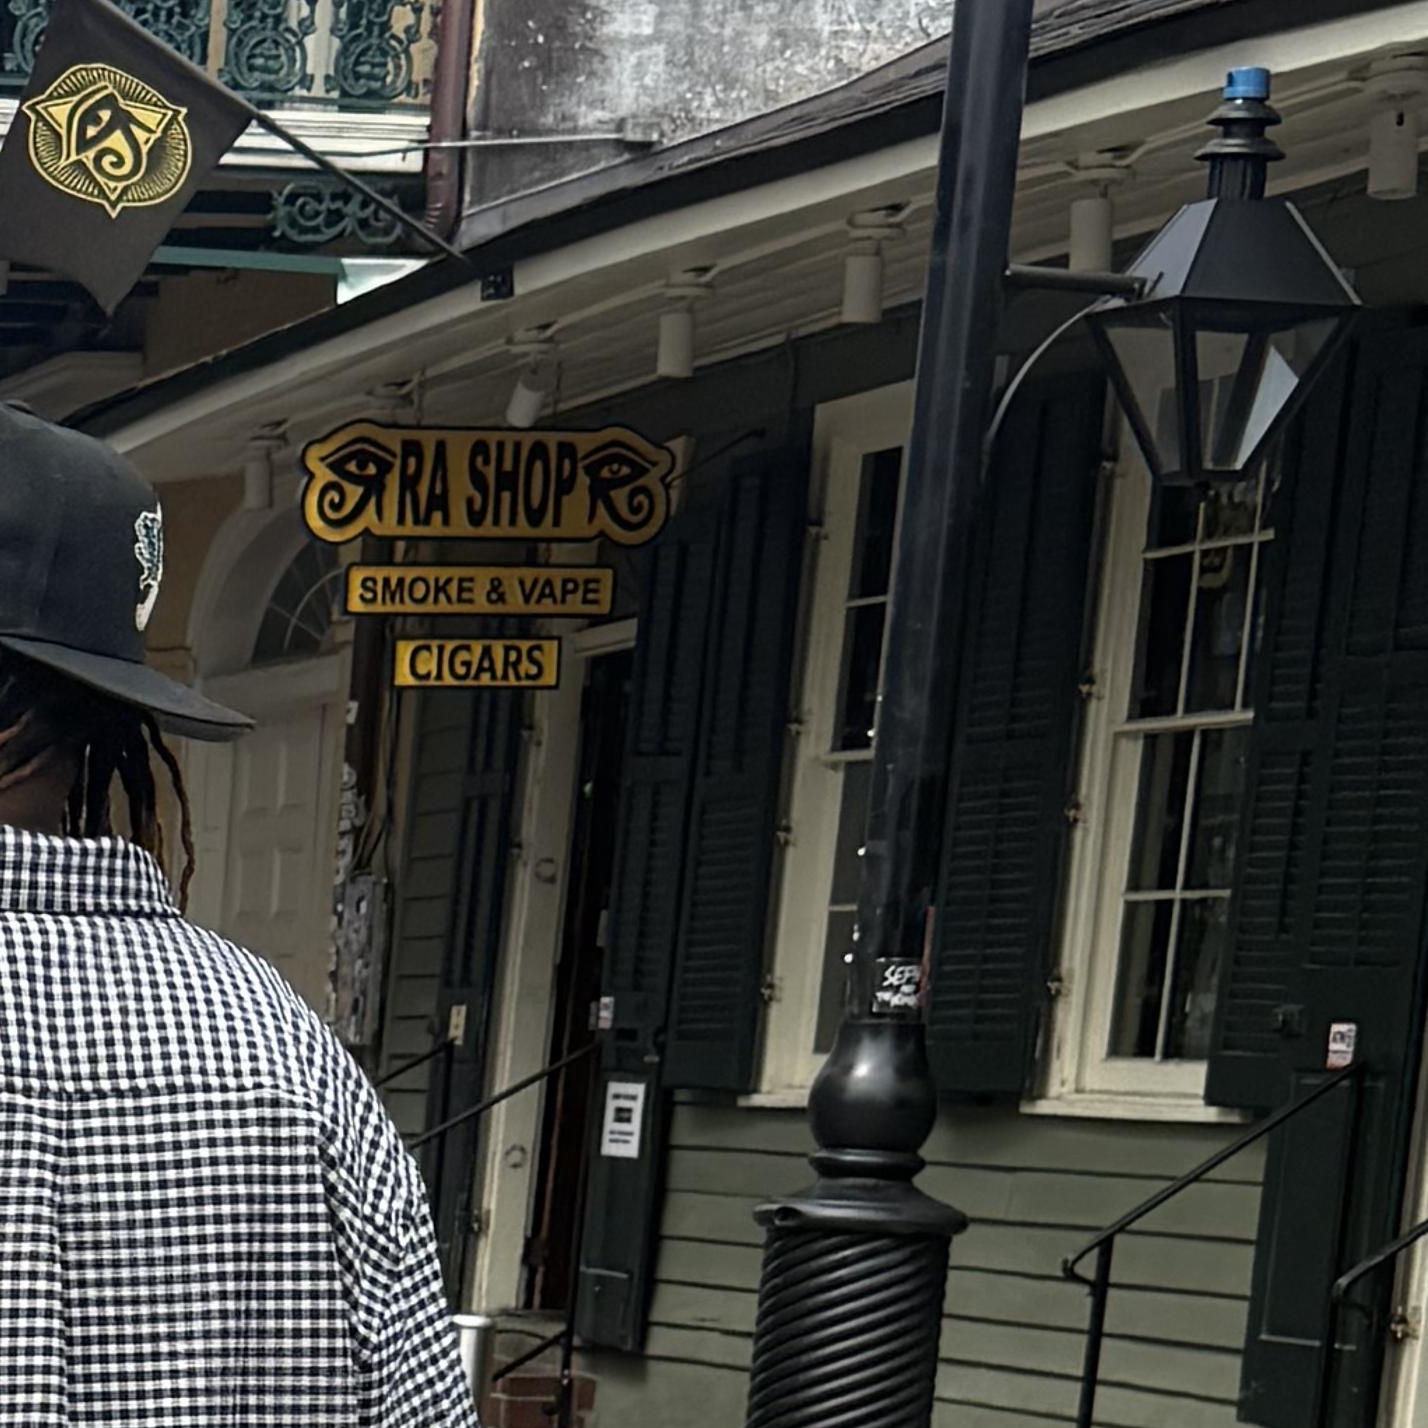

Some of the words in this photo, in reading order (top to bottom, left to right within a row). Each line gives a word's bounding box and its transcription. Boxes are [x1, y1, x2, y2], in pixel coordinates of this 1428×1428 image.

[396, 438, 450, 527] RA
[467, 440, 578, 529] SHOP
[359, 576, 474, 605] SMOKE
[486, 577, 505, 605] &
[518, 577, 600, 606] VAPE
[409, 644, 544, 682] CIGARS
